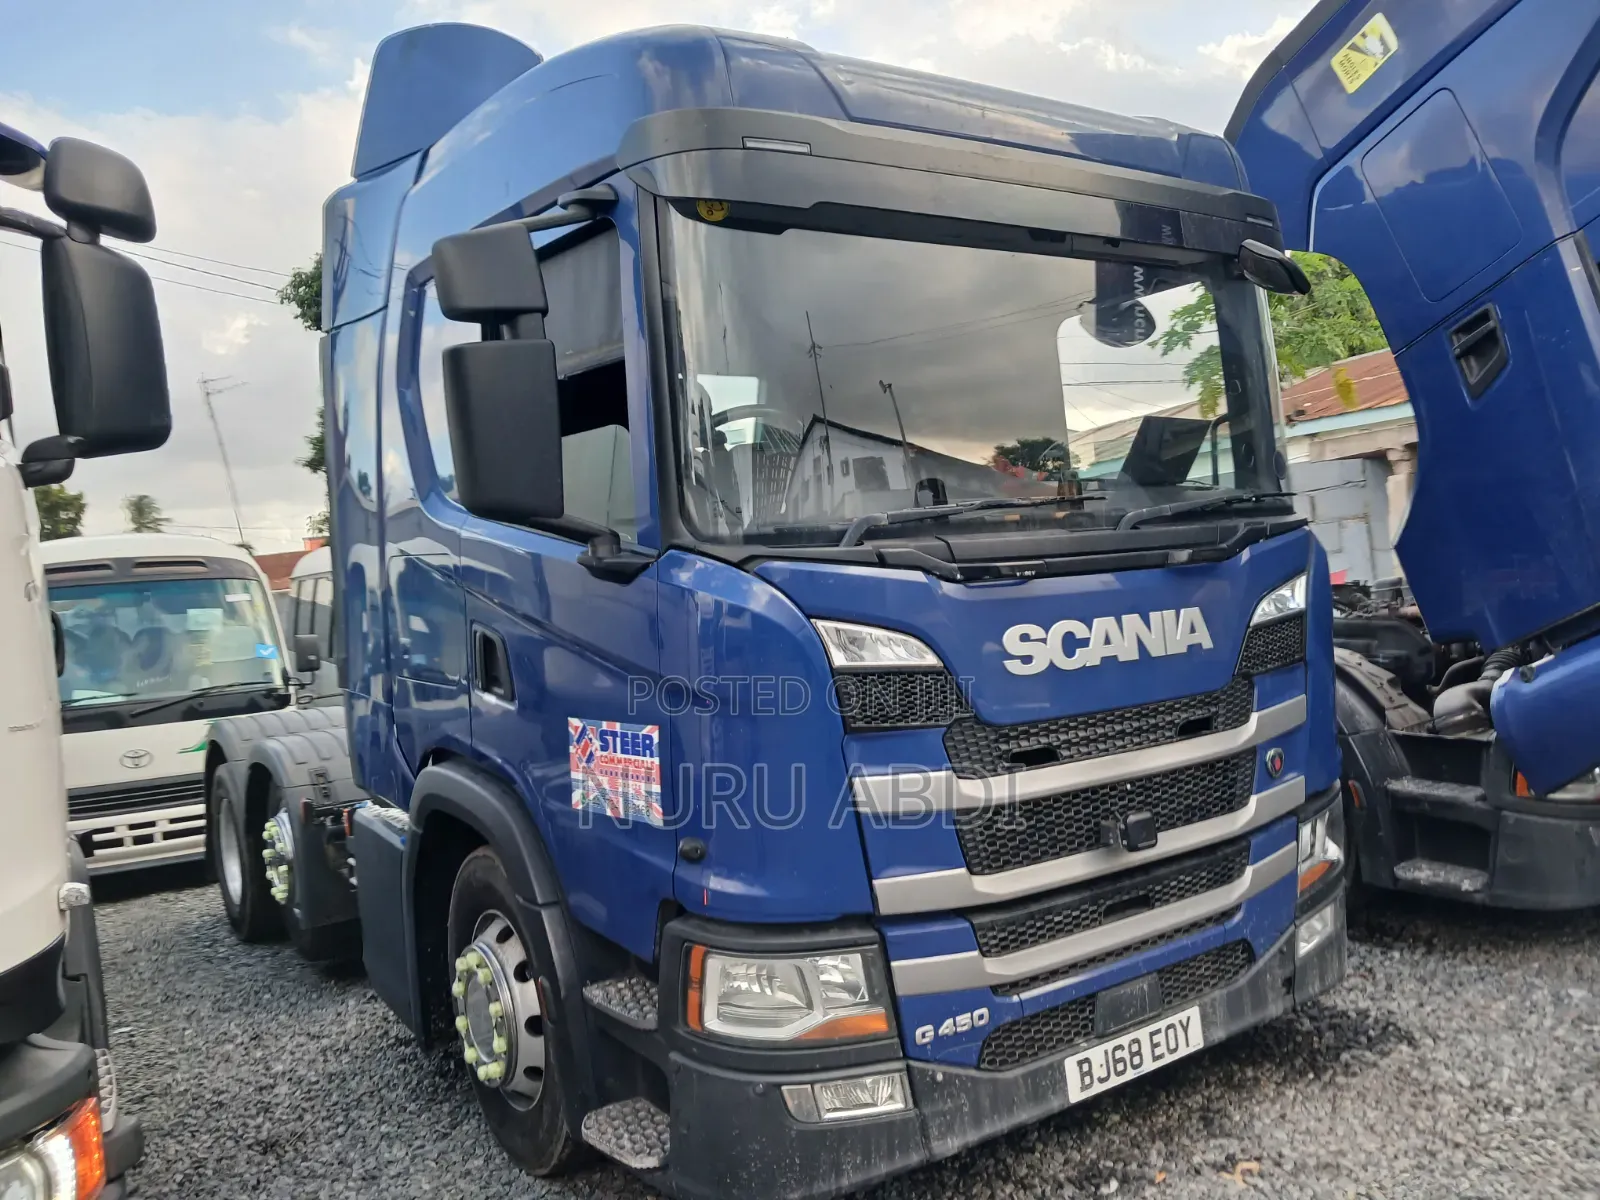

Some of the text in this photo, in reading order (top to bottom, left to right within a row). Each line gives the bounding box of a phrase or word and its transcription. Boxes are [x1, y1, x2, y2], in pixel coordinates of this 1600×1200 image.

[1002, 606, 1214, 676] SCANIA
[599, 728, 656, 758] STEER
[915, 1007, 990, 1046] G 450
[1076, 1015, 1192, 1093] BJ68 EOY
